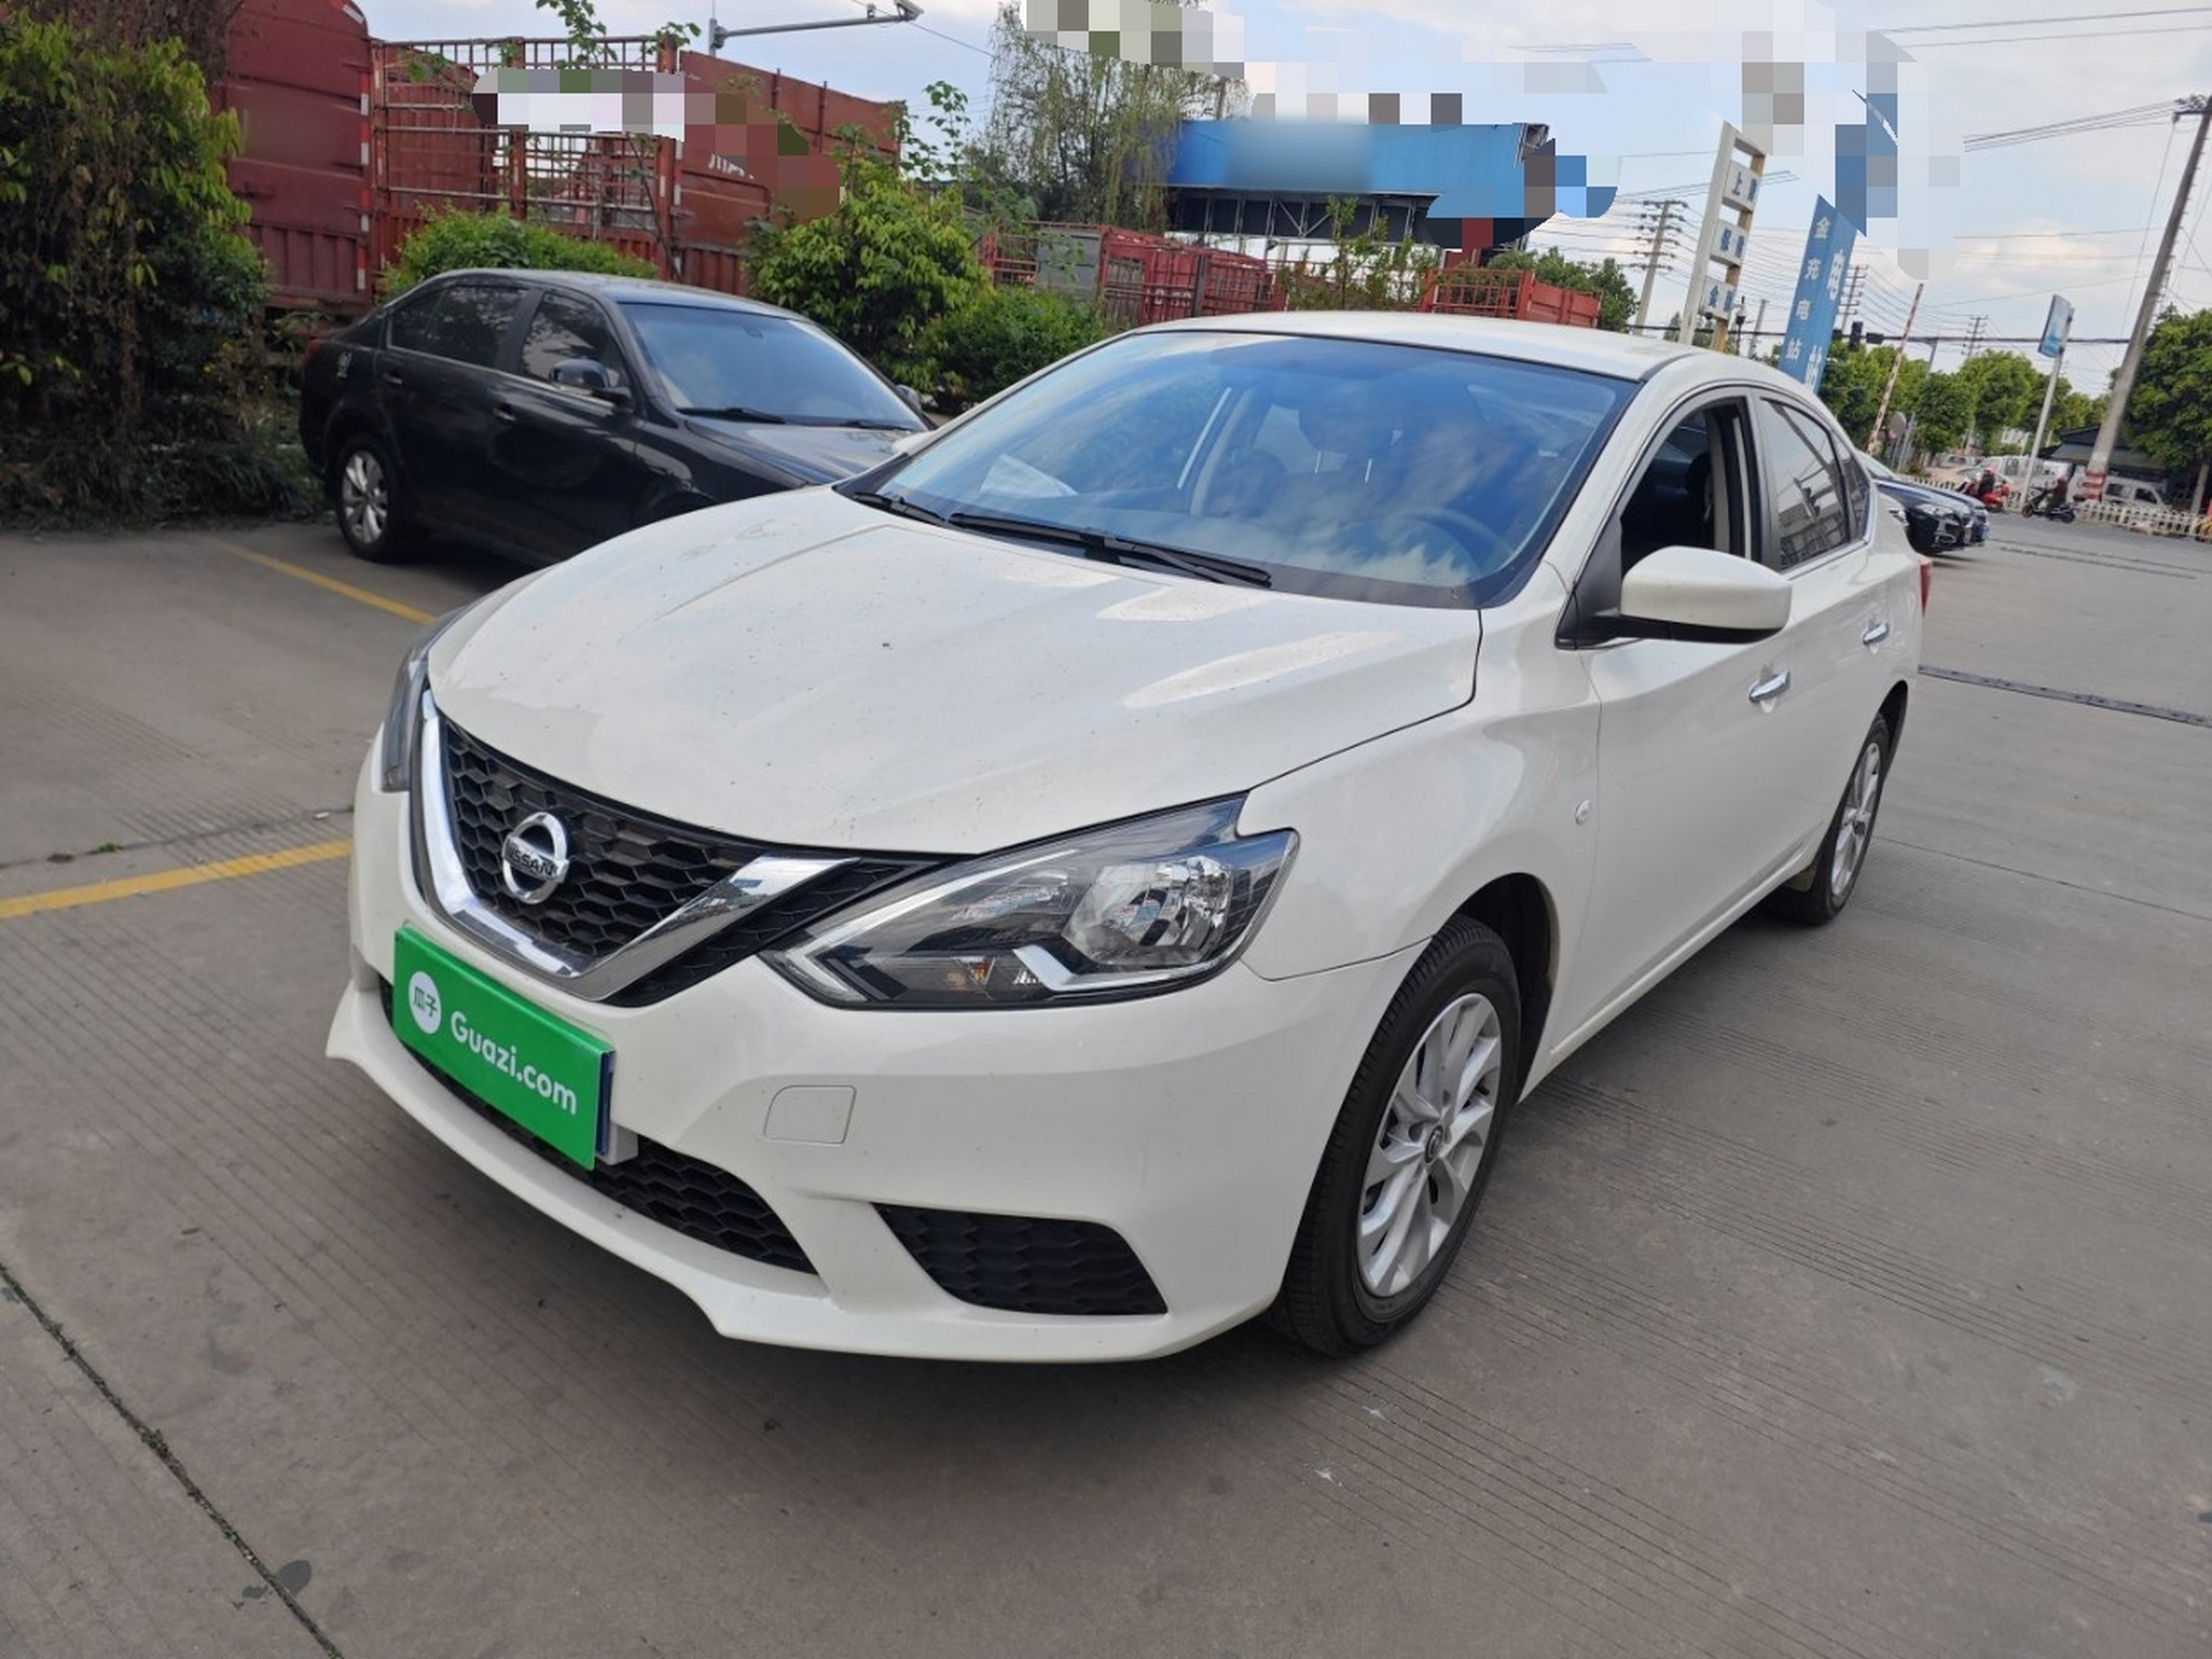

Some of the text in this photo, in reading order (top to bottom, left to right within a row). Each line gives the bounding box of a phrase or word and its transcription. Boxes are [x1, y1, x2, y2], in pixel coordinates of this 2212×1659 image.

[505, 836, 559, 880] NISSAN
[412, 985, 438, 1018] 瓜子
[450, 1010, 577, 1115] Guazi.com
